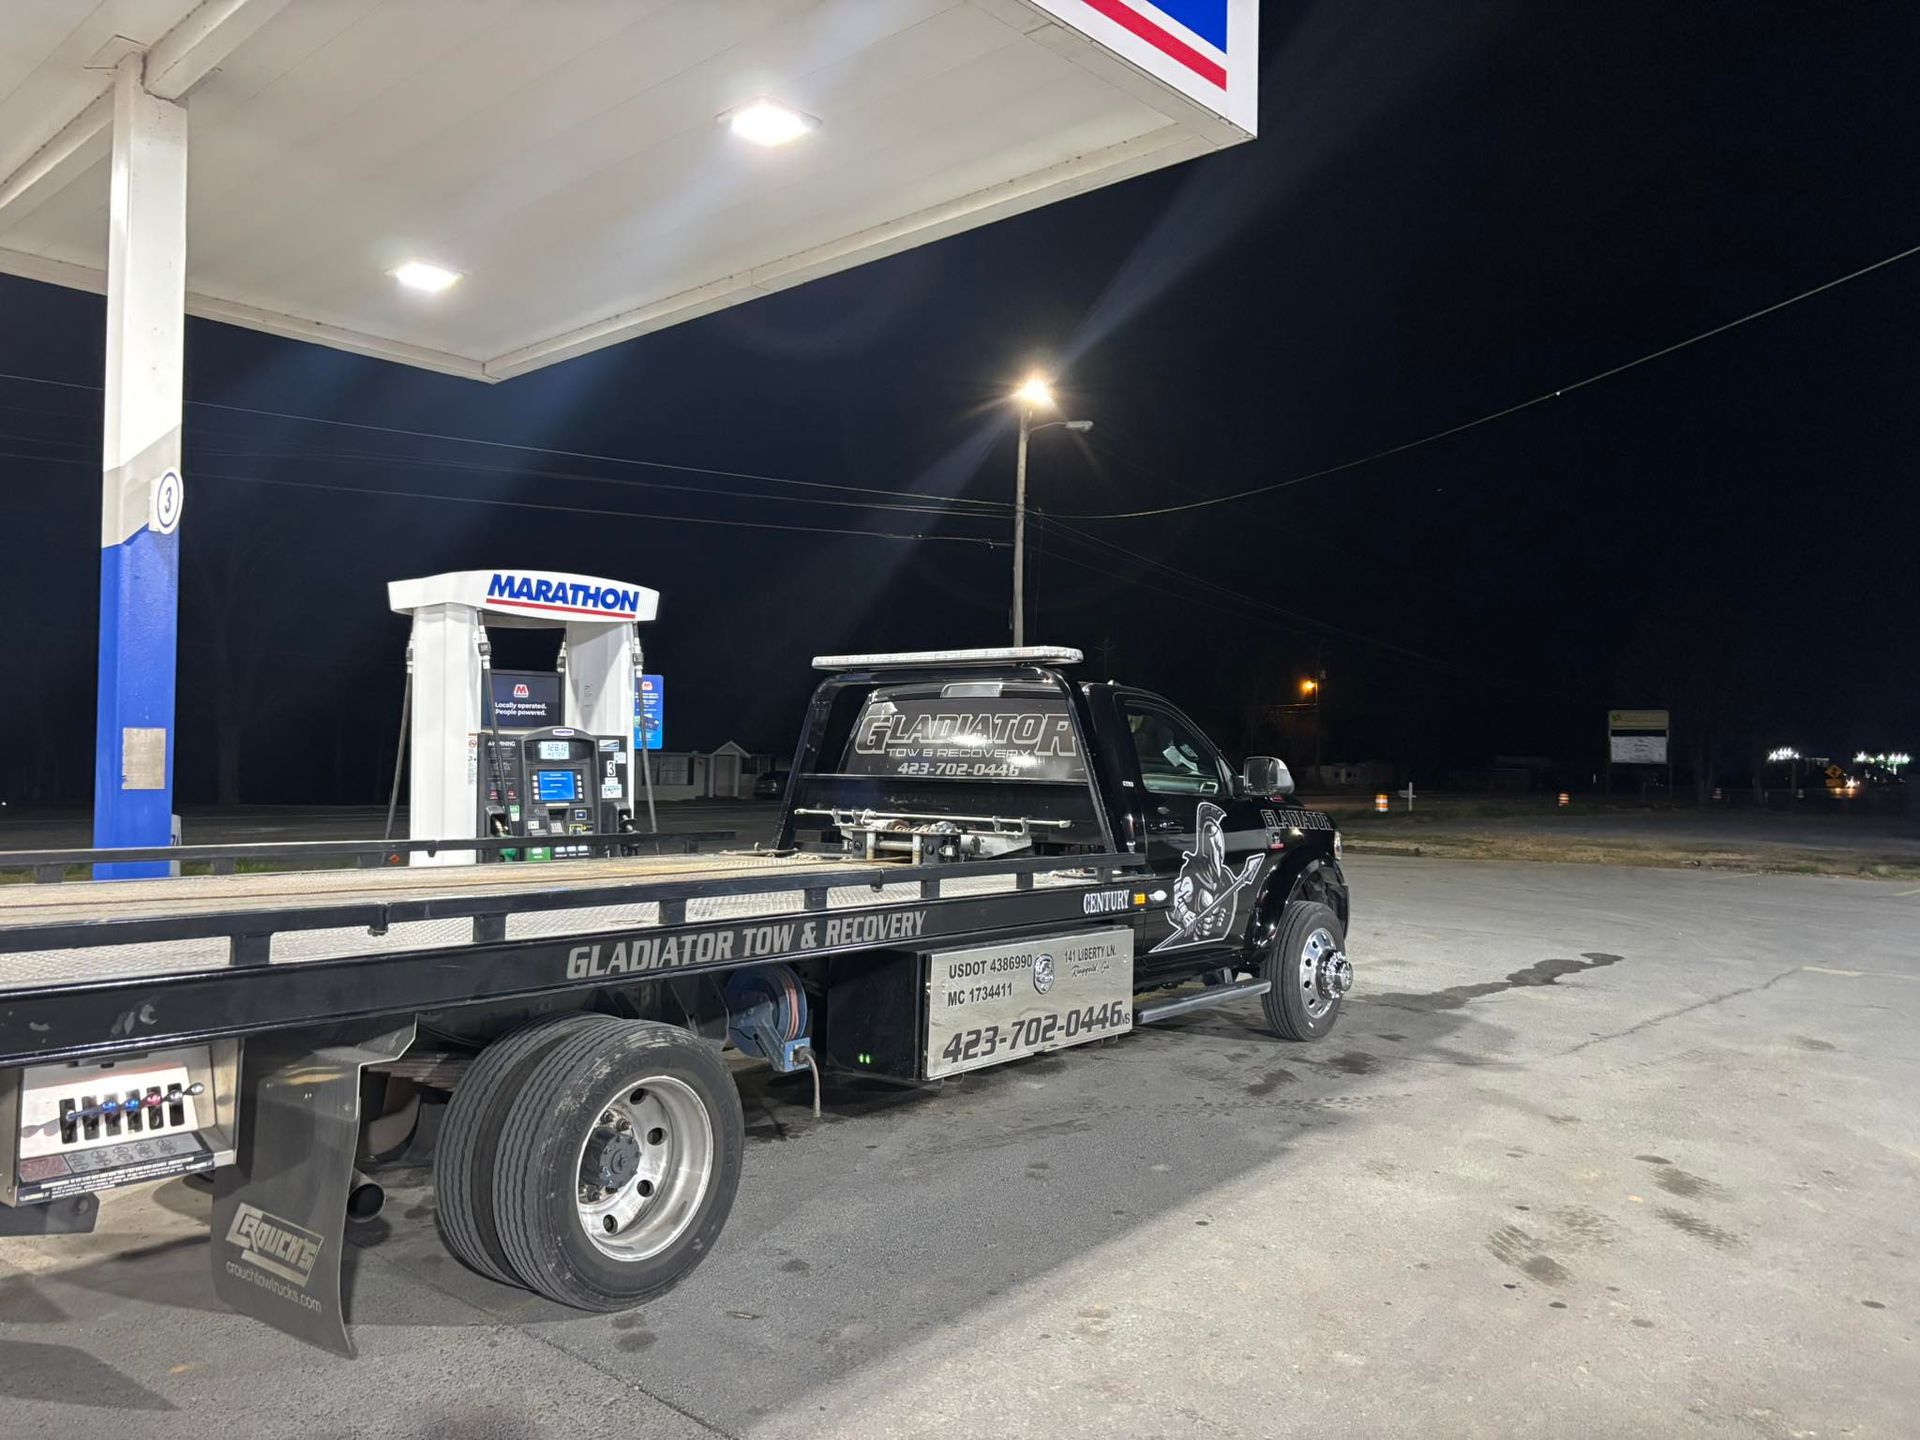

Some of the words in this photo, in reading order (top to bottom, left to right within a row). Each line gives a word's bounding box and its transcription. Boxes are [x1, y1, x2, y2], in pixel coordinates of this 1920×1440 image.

[164, 486, 173, 514] 3
[487, 573, 640, 612] MARATHON
[494, 702, 516, 710] Locally
[855, 713, 1077, 757] GLADIATOR
[886, 748, 921, 758] TOW
[922, 748, 933, 758] &
[936, 748, 1032, 759] RECOVERY
[608, 762, 615, 776] 3
[897, 762, 1021, 777] 423-702-0446
[1083, 889, 1130, 915] CENTURY
[566, 930, 735, 980] GLADIATOR
[742, 924, 796, 957] TOW
[800, 921, 818, 950] &
[825, 910, 928, 947] RECOVERY
[1064, 949, 1076, 964] 141
[1077, 945, 1105, 962] LIBERTY
[949, 960, 988, 980] USDOT
[989, 953, 1033, 973] 4386990
[948, 990, 965, 1007] MC
[969, 982, 1013, 1003] 1734411
[943, 1000, 1123, 1064] 423-702-0446
